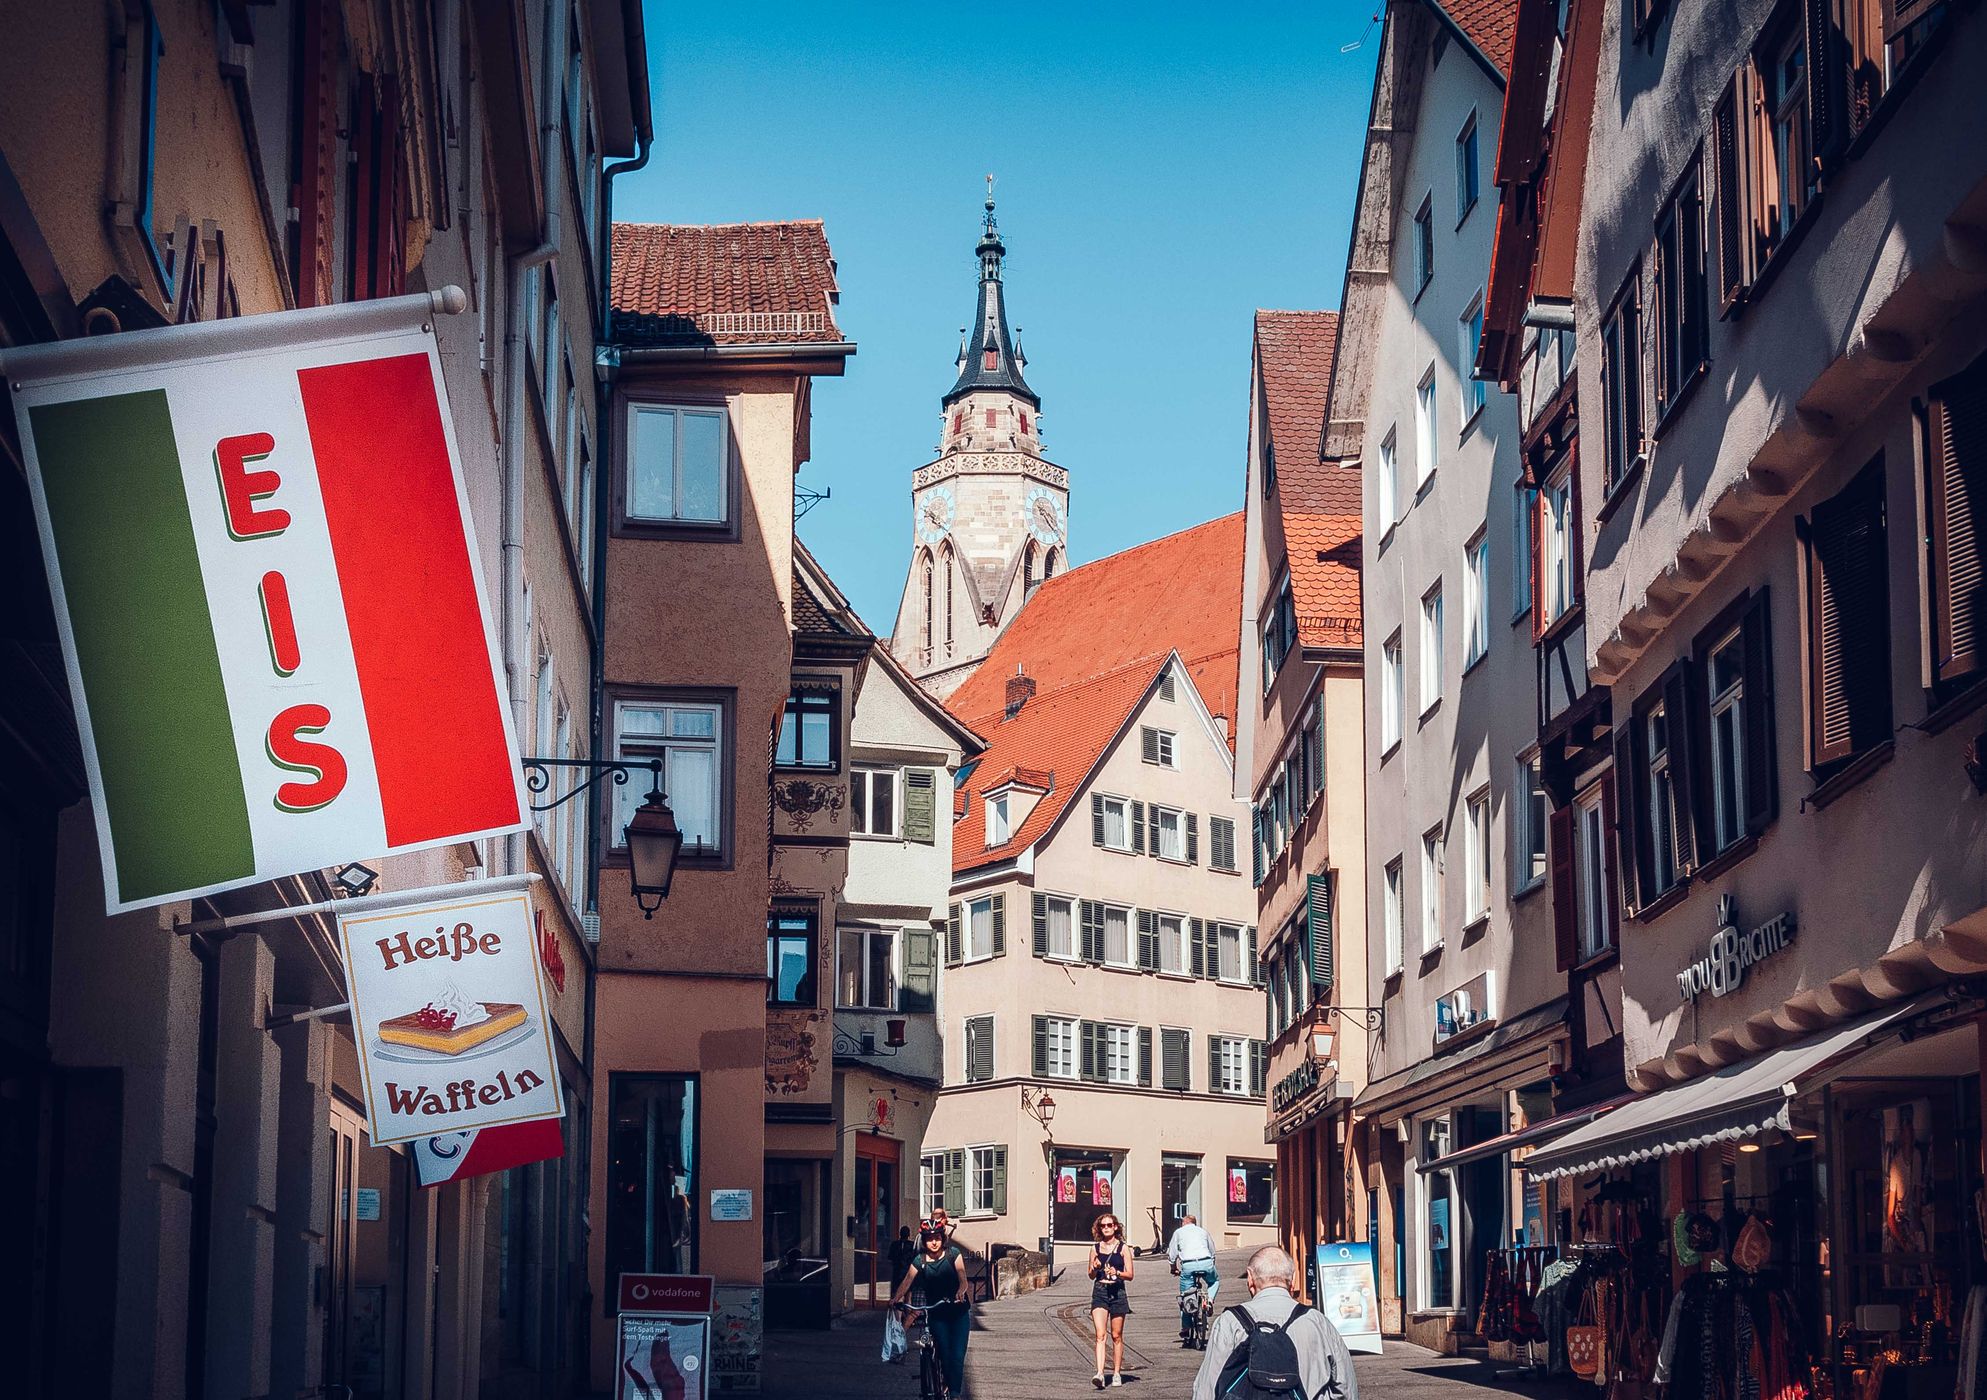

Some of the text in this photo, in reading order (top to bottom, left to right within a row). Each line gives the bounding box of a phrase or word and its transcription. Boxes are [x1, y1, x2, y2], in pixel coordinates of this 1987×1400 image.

[212, 432, 348, 814] EIS
[375, 922, 502, 971] Heiße
[1676, 912, 1791, 1005] BIJOU BRIGITTE
[384, 1068, 545, 1116] Waffeln
[652, 1286, 701, 1298] vodafone
[622, 1325, 654, 1334] Surf-Spaß
[622, 1333, 672, 1343] dem Testsieger
